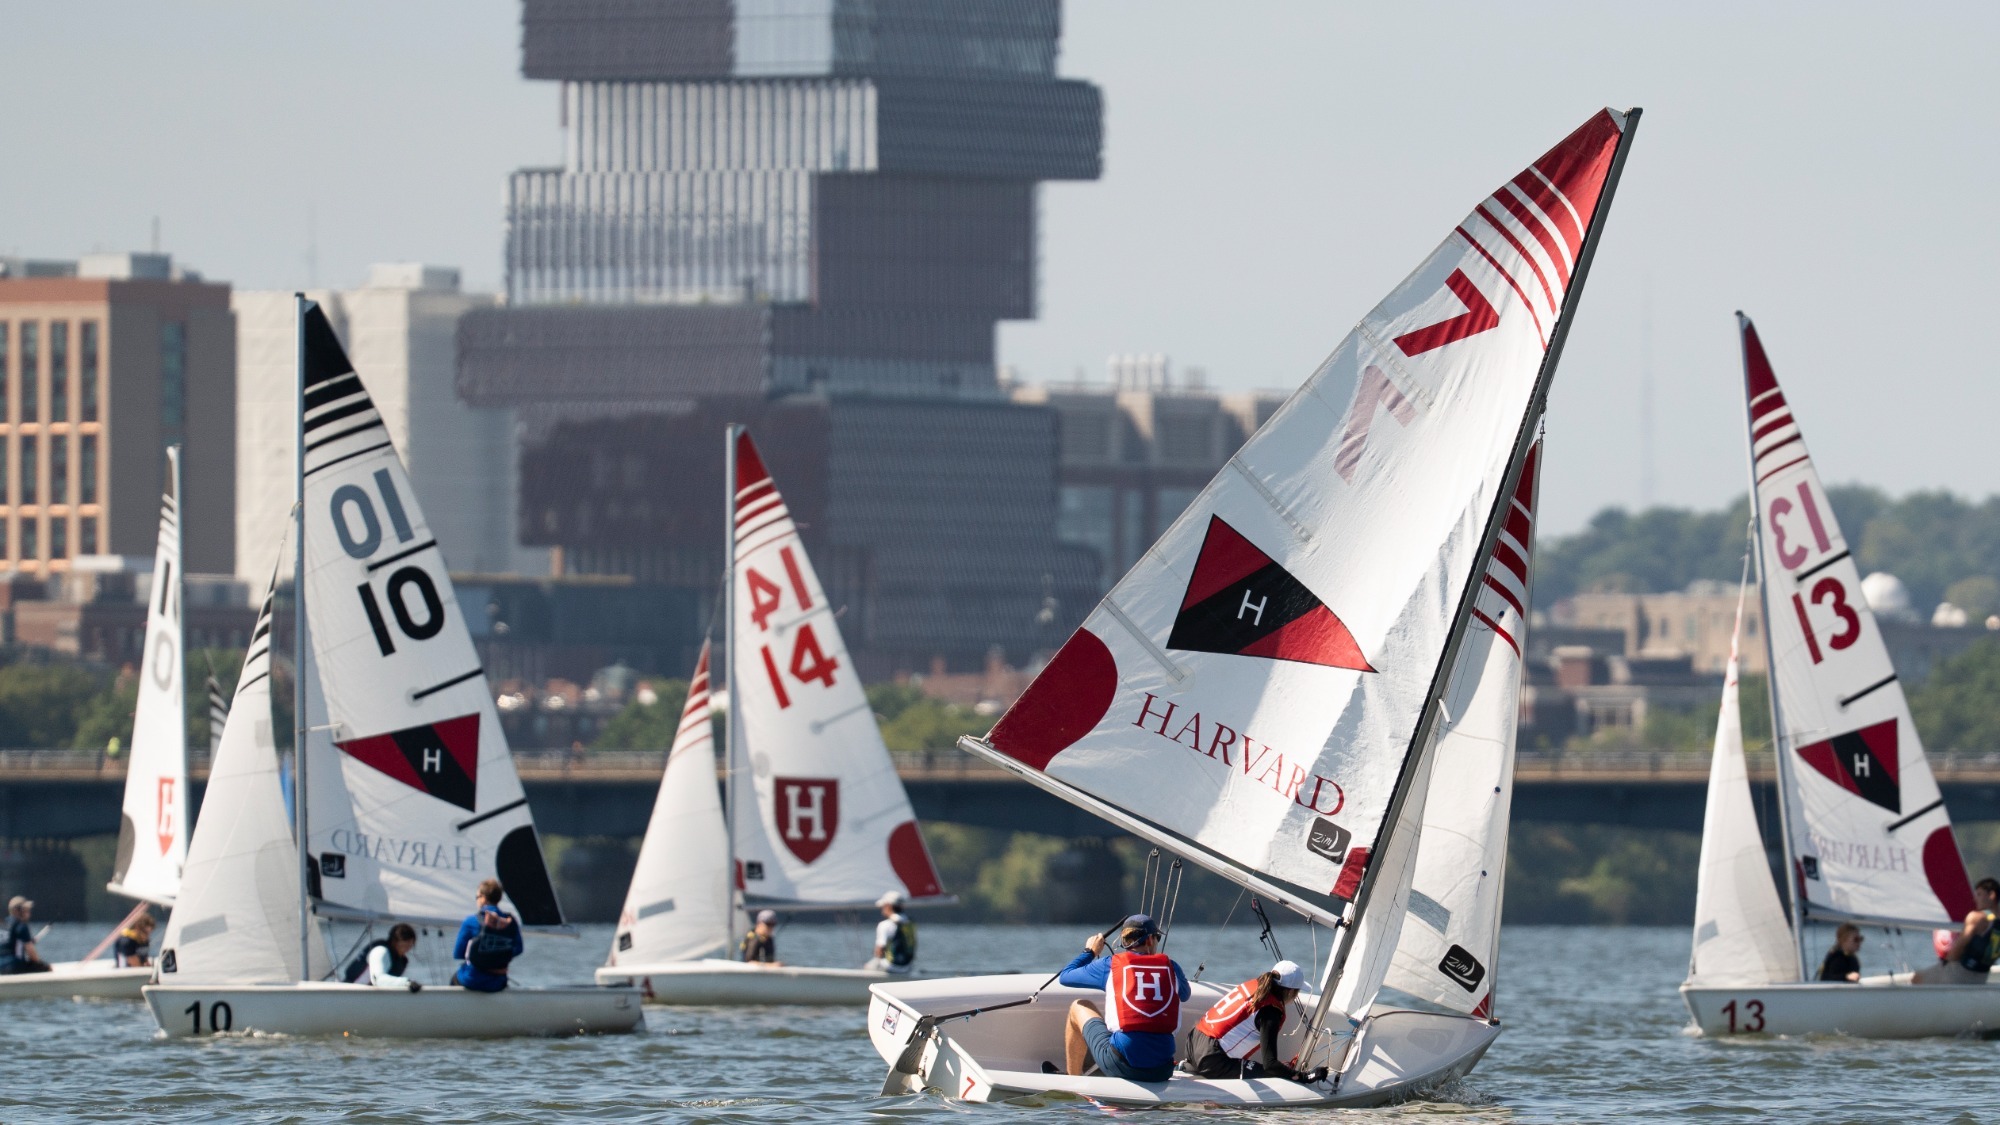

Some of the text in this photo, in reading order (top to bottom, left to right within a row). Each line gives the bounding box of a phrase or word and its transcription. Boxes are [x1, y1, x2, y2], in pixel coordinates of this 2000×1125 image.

[1392, 267, 1500, 358] 7
[357, 565, 445, 658] 10
[1237, 589, 1267, 626] H
[1792, 577, 1861, 665] 13
[760, 622, 840, 710] 14
[423, 748, 441, 773] H
[1131, 692, 1345, 816] HARVARD
[1854, 752, 1870, 777] H
[785, 785, 826, 840] H
[1134, 971, 1163, 1000] H
[1214, 987, 1245, 1015] H
[185, 1001, 232, 1034] 10
[1721, 999, 1765, 1033] 13
[961, 1076, 976, 1099] 7
